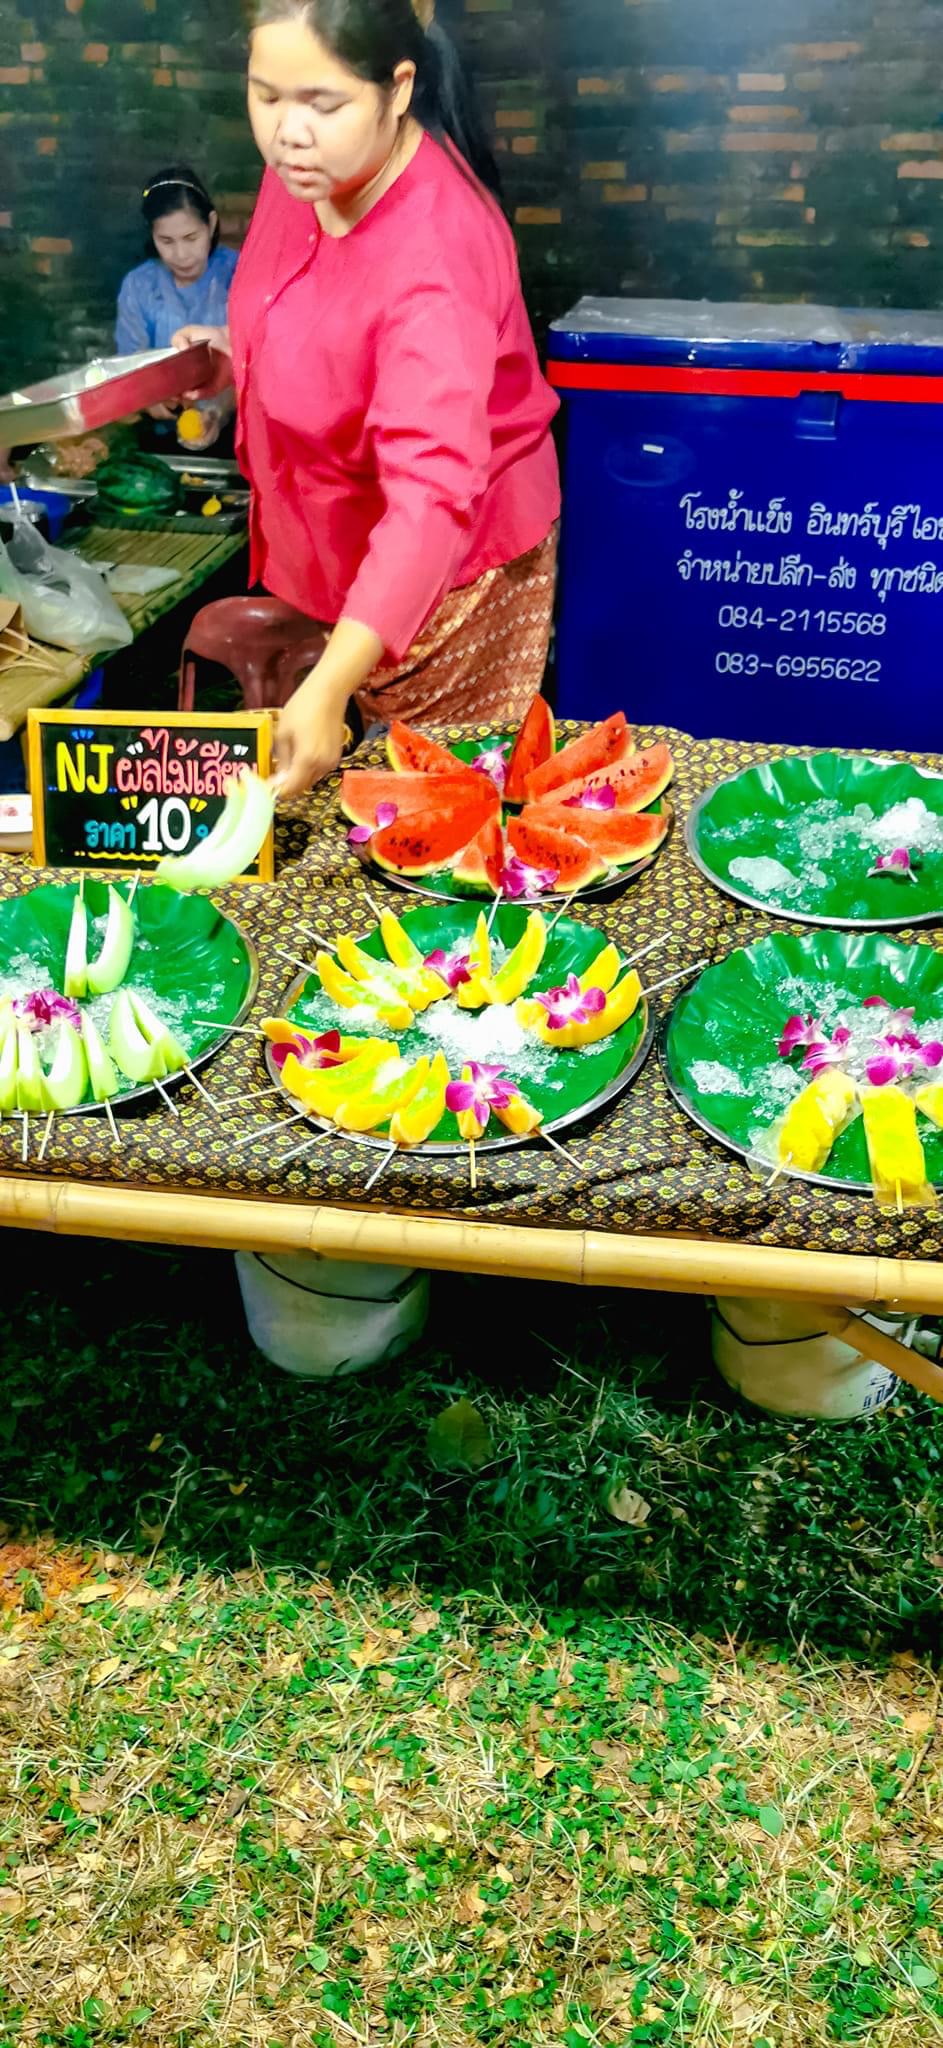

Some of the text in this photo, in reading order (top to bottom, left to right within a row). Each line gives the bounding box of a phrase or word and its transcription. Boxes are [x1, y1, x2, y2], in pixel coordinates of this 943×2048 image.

[679, 488, 793, 534] โรงน้ำแข็ง
[718, 604, 887, 635] 084-2115568
[715, 651, 882, 683] 083-6955622
[55, 741, 114, 794] NJ
[84, 819, 136, 849] ราคา
